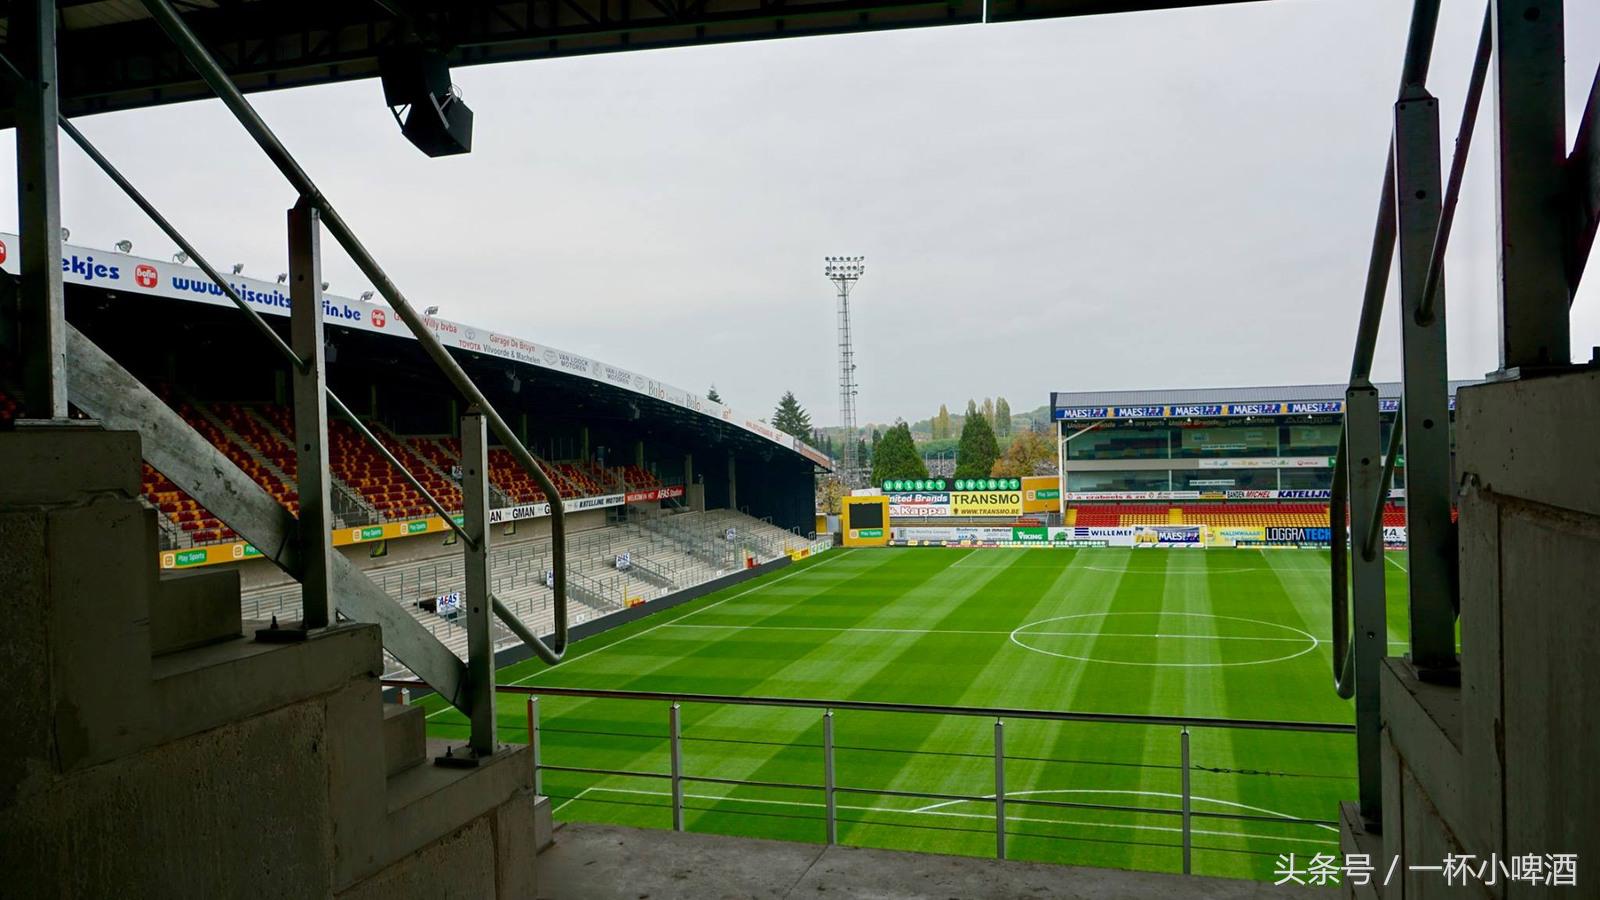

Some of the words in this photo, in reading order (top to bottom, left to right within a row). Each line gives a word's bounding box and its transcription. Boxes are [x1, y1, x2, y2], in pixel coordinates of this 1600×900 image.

[459, 340, 480, 351] TOYOTA
[1119, 408, 1143, 417] MAES
[1175, 406, 1200, 416] MAES
[1233, 405, 1258, 414] MAES
[1292, 403, 1318, 413] MAES
[1064, 409, 1087, 418] MAES
[883, 480, 946, 491] UNIBET
[955, 479, 1020, 490] UNIBET
[890, 494, 914, 504] nited
[915, 493, 947, 503] Brands
[953, 494, 1020, 505] TRANSMO
[513, 507, 535, 519] GMAN
[901, 506, 947, 516] Kappa
[1018, 531, 1043, 540] VIKING
[1158, 531, 1183, 541] MAES
